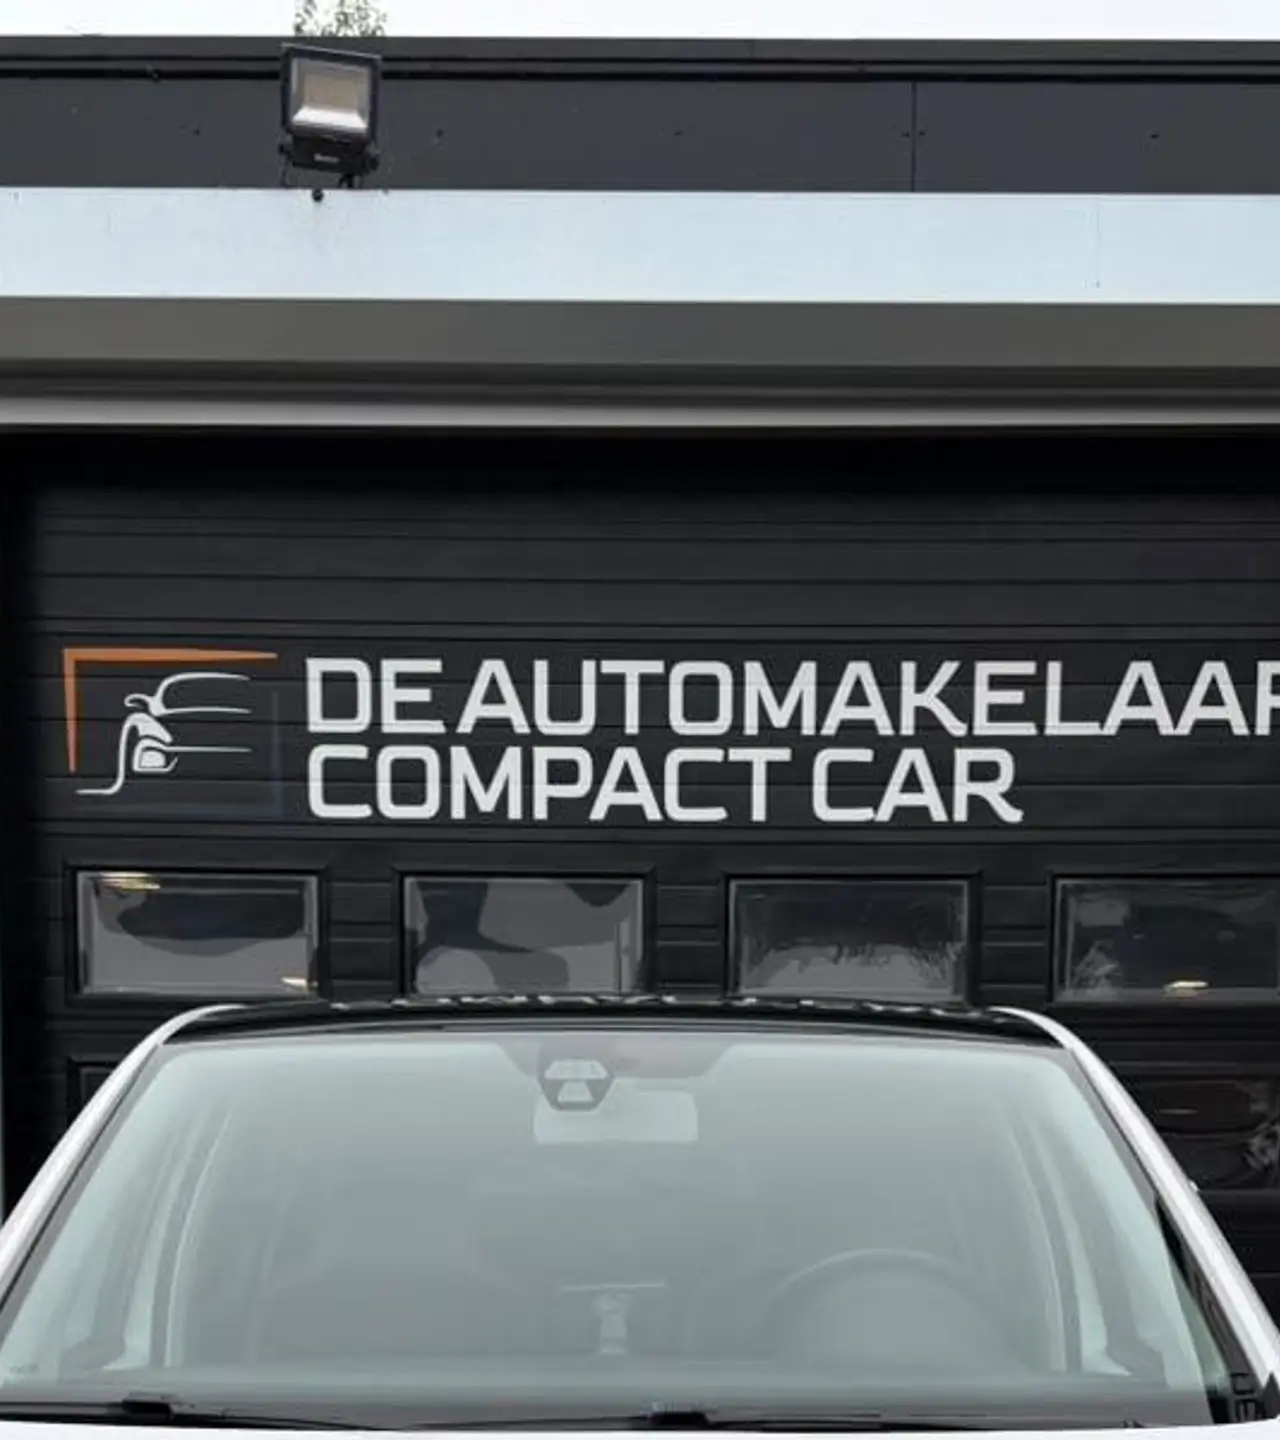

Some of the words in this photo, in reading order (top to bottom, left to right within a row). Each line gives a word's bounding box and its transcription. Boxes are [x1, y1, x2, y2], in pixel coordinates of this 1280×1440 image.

[306, 658, 444, 735] DE
[306, 745, 791, 821] COMPACT
[811, 746, 1024, 823] CAR
